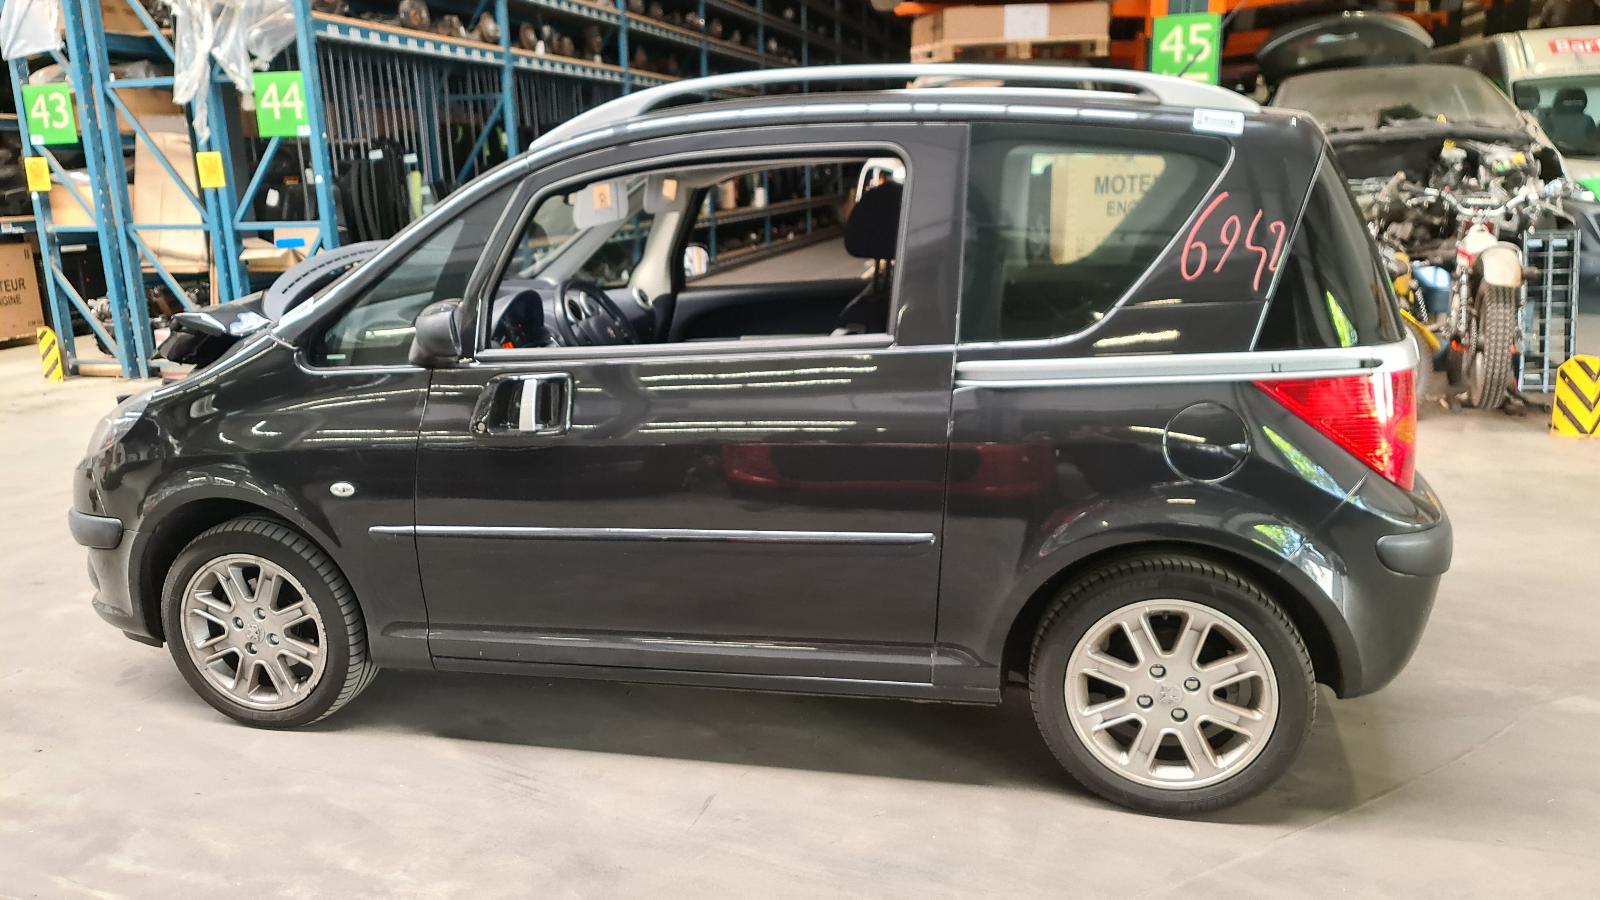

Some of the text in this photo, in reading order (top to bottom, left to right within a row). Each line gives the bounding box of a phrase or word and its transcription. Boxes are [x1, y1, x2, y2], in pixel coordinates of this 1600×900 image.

[1159, 23, 1212, 63] 45
[31, 92, 70, 129] 43
[260, 82, 304, 120] 44
[1094, 174, 1157, 194] MOTE
[1181, 192, 1286, 291] 6942
